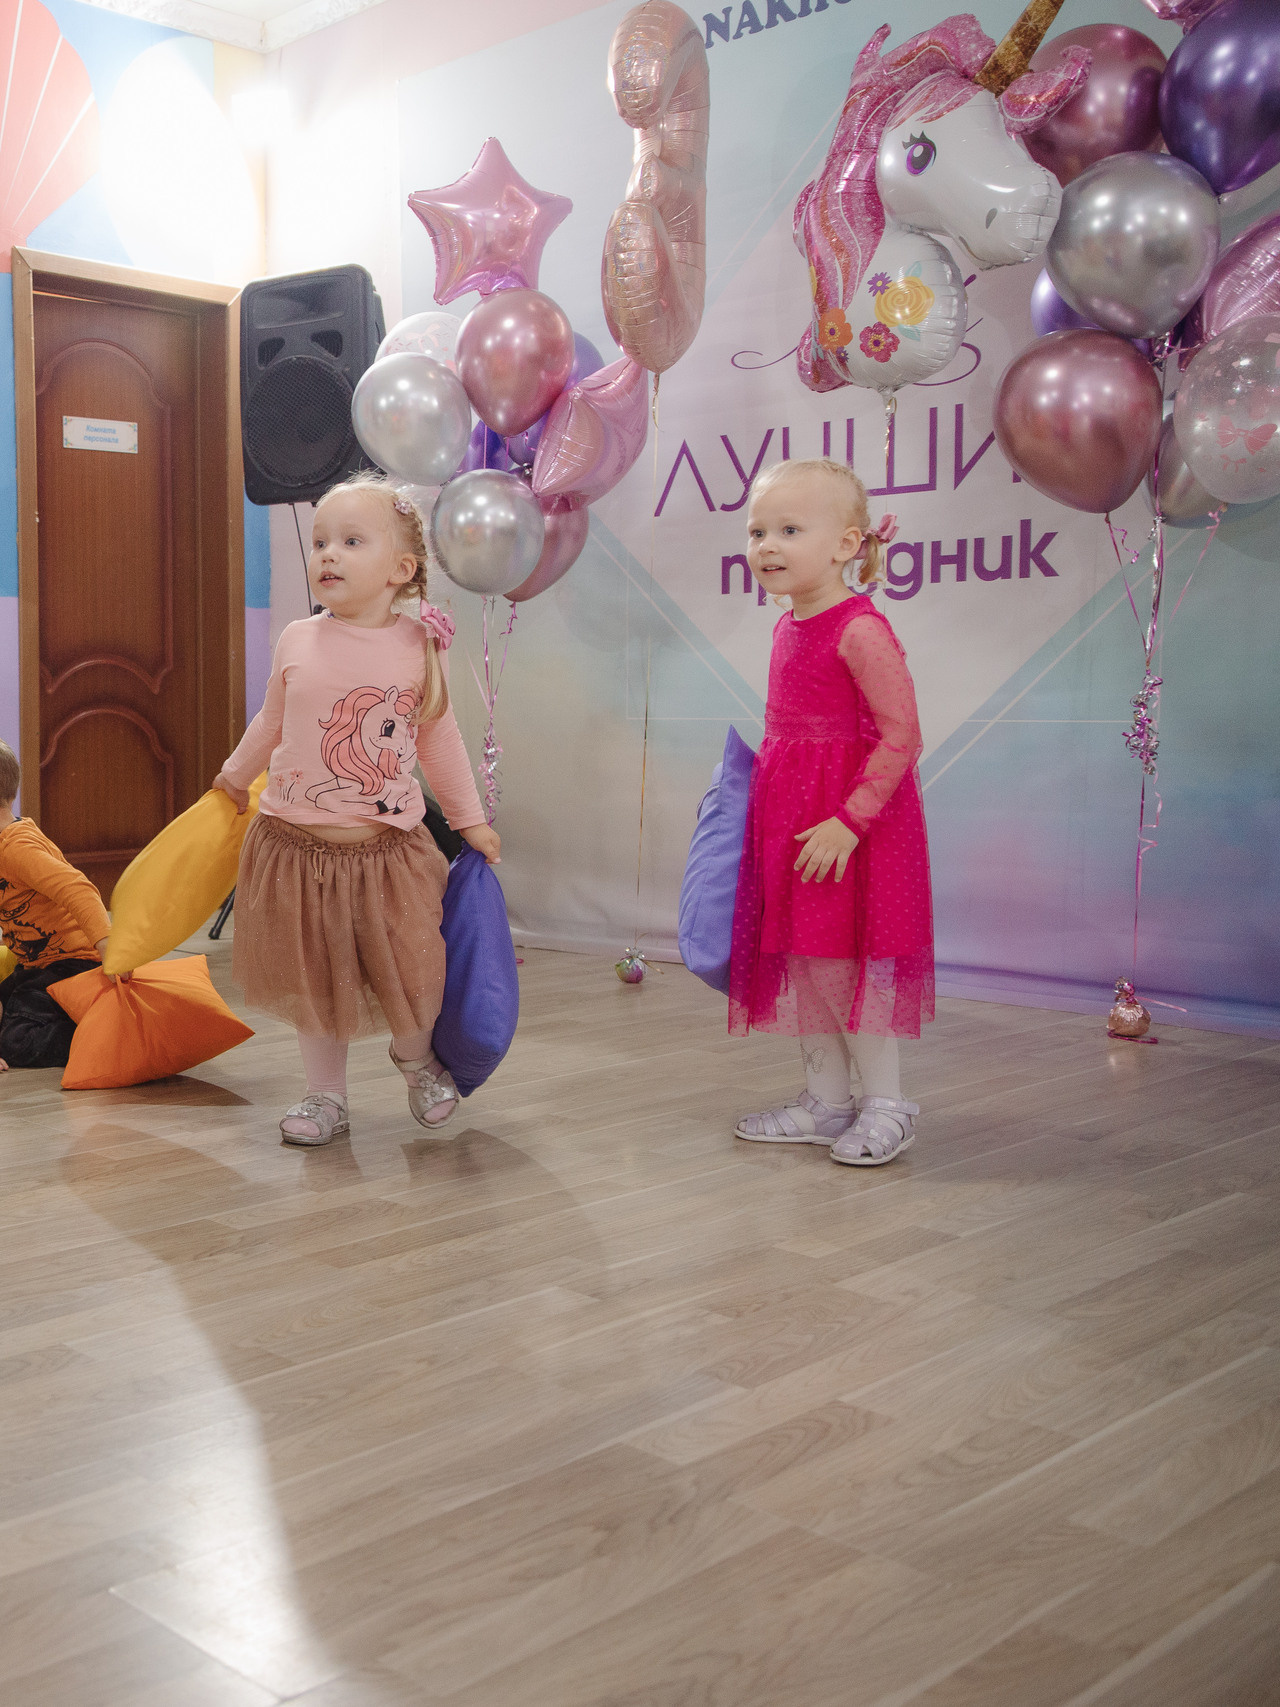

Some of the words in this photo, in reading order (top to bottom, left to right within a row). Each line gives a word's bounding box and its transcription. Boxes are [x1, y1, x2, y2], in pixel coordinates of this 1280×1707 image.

[702, 0, 852, 49] NAK
[86, 424, 117, 435] Комната
[653, 402, 1022, 518] ЛУШИ
[721, 518, 1060, 607] пдник
